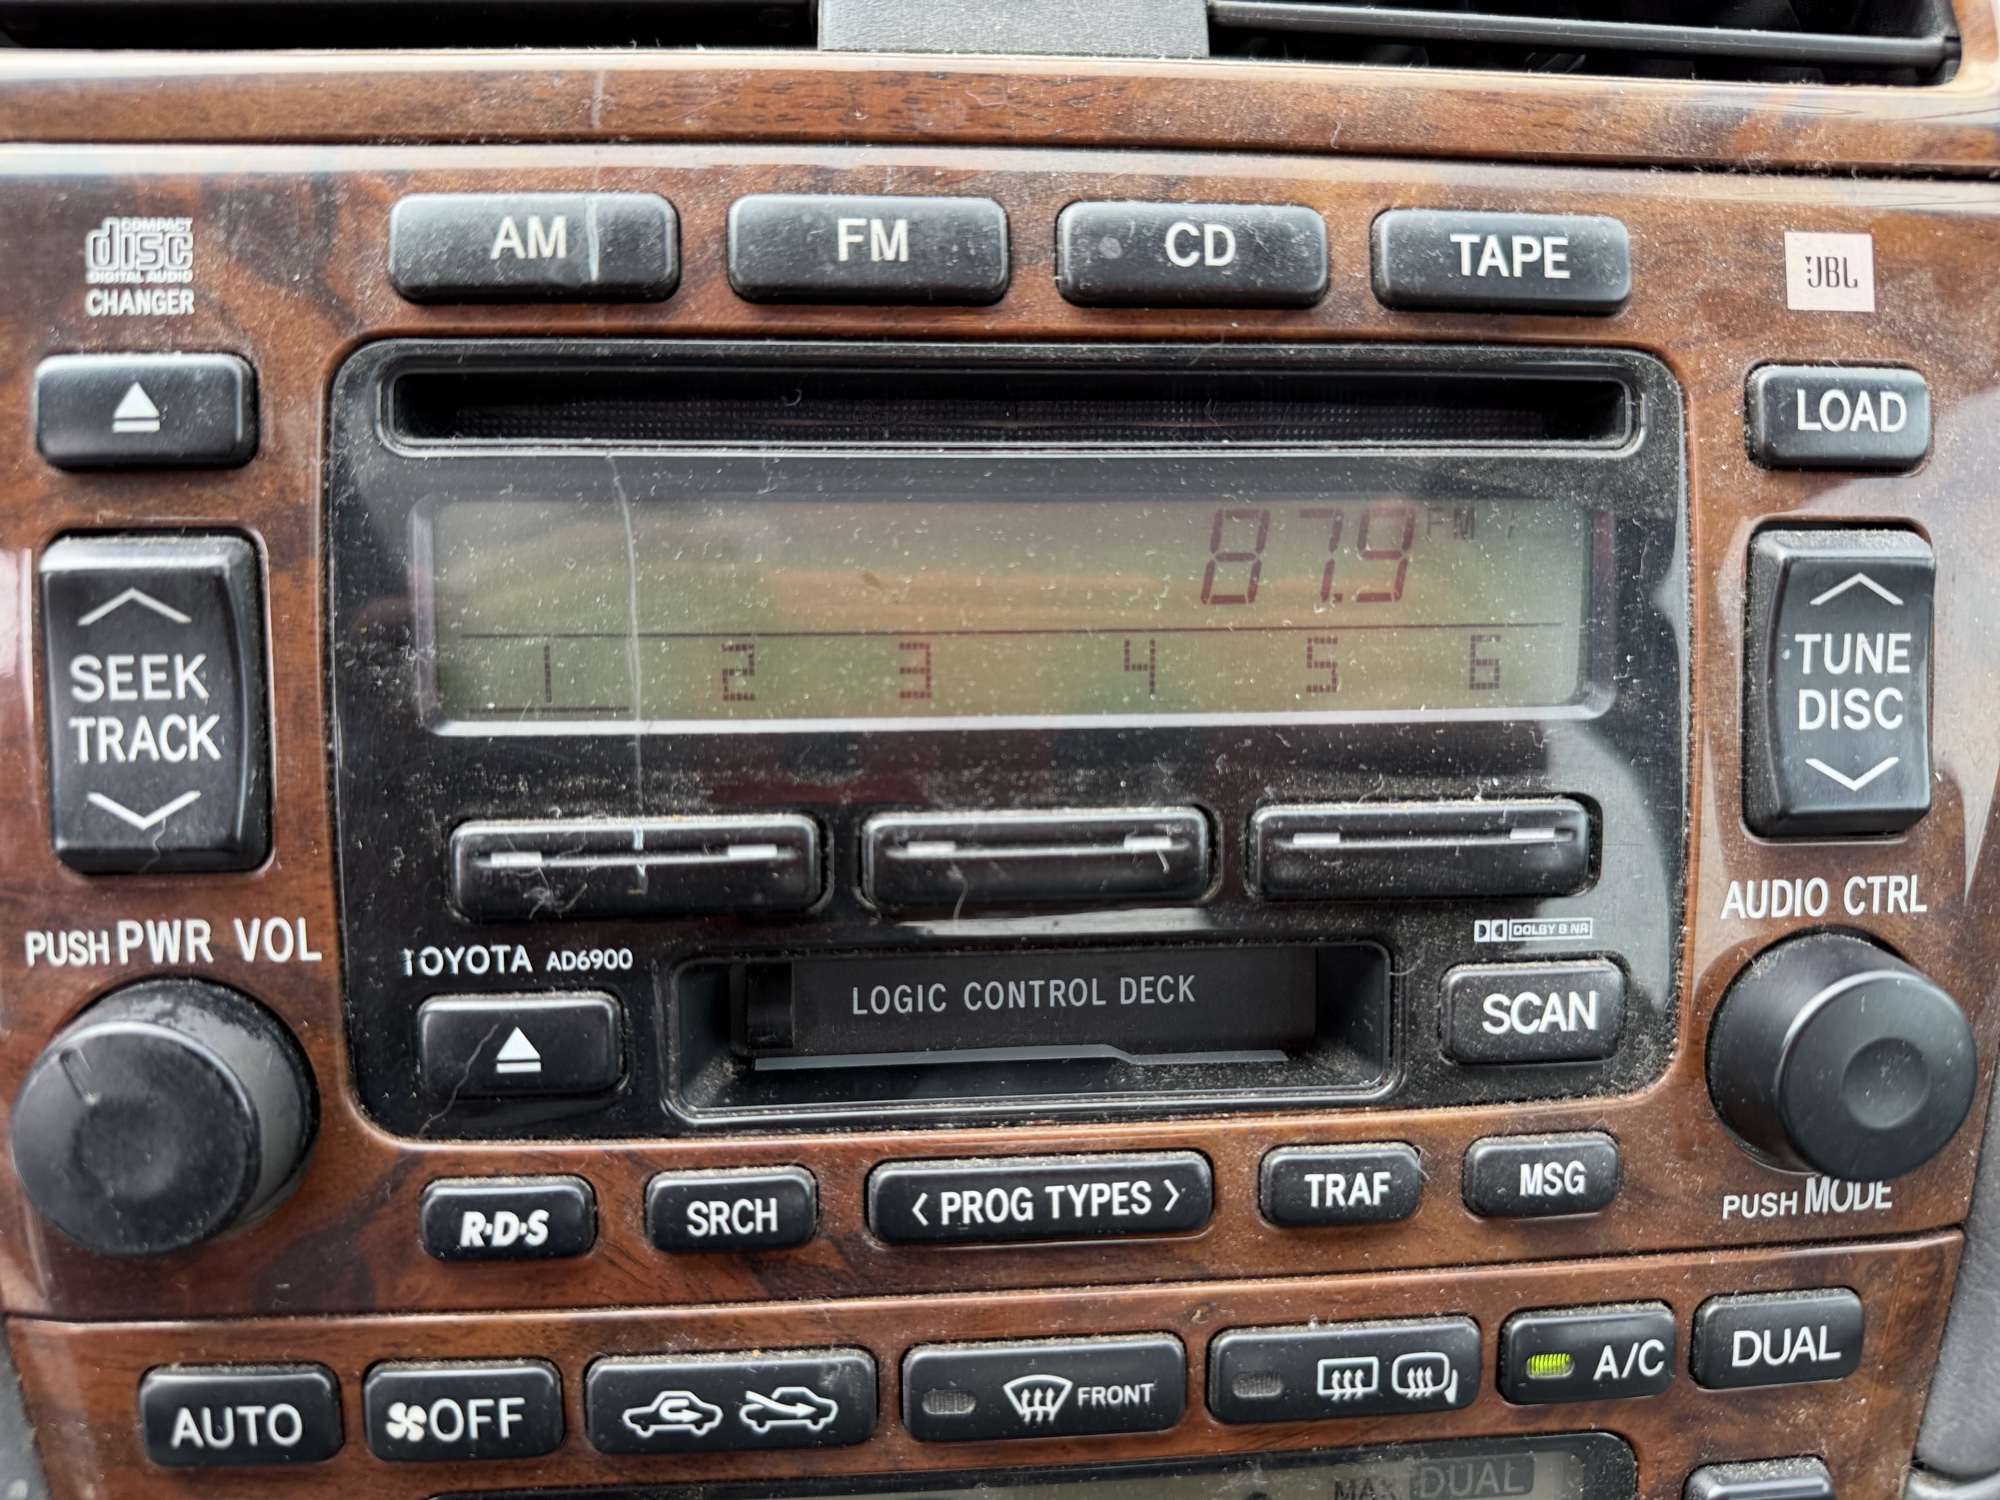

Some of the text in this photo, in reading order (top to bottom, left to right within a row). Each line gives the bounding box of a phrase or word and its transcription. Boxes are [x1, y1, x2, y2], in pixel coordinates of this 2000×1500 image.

[120, 217, 193, 232] COMPACT
[491, 216, 567, 261] AM
[836, 218, 909, 263] FM
[1164, 221, 1237, 268] CD
[85, 269, 193, 284] DIGITAL AUDIO
[1448, 233, 1571, 280] TAPE
[1805, 256, 1858, 289] JBL
[85, 288, 195, 317] CHANGER
[1796, 389, 1907, 434] LOAD
[1201, 507, 1416, 605] 87.9
[1427, 507, 1475, 540] FM
[722, 642, 755, 701] 2
[899, 641, 932, 698] 3
[1123, 639, 1157, 695] 4
[1306, 635, 1338, 692] 5
[1470, 634, 1501, 691] 6
[1794, 633, 1911, 675] TUNE
[69, 653, 211, 703] SEEK
[1798, 689, 1904, 731] DISC
[69, 714, 222, 764] TRACK
[1720, 875, 1927, 920] AUDIO CTRL
[25, 917, 322, 967] PUSH PWR VOL
[1513, 922, 1589, 936] DOLBY B NR
[546, 948, 634, 972] AD6900
[851, 974, 1197, 1016] LOGIC CONTROL DECK
[1481, 991, 1598, 1035] SCAN
[1303, 1171, 1391, 1208] TRAF
[1519, 1162, 1587, 1197] MSG
[1722, 1176, 1893, 1220] PUSH MODE
[686, 1198, 779, 1237] SRCH
[940, 1181, 1152, 1226] PROG TYPES
[1592, 1338, 1665, 1381] A/C
[1731, 1326, 1842, 1367] DUAL
[1077, 1382, 1155, 1407] FRONT
[171, 1402, 303, 1448] AUTO
[429, 1397, 526, 1442] OFF
[1418, 1460, 1524, 1499] DUAL
